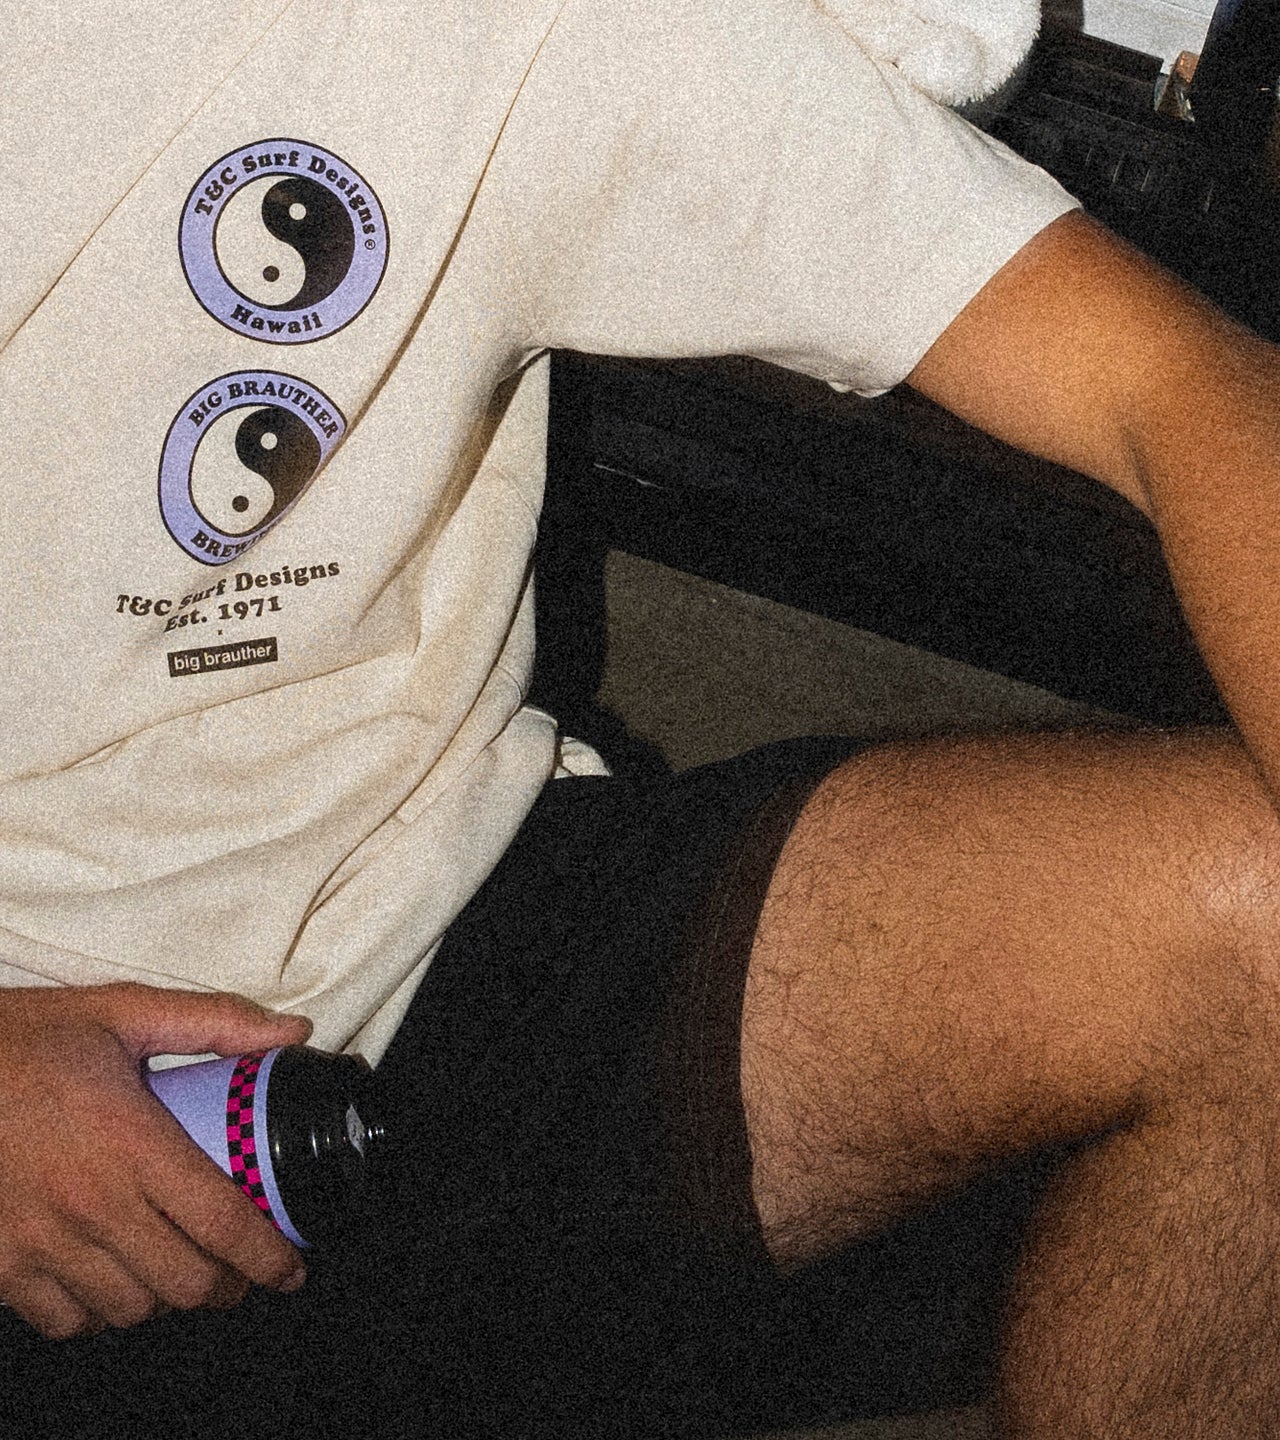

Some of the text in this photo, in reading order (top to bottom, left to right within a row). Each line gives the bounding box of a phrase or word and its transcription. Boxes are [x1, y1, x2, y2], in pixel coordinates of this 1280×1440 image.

[193, 149, 377, 235] T&C Surf Designs
[230, 303, 324, 335] Hawaii
[188, 379, 340, 439] BIG BRAUTHER
[115, 592, 173, 618] T&C
[233, 560, 341, 593] Designs
[162, 594, 283, 634] Est. 1971
[172, 641, 274, 672] big brauther
